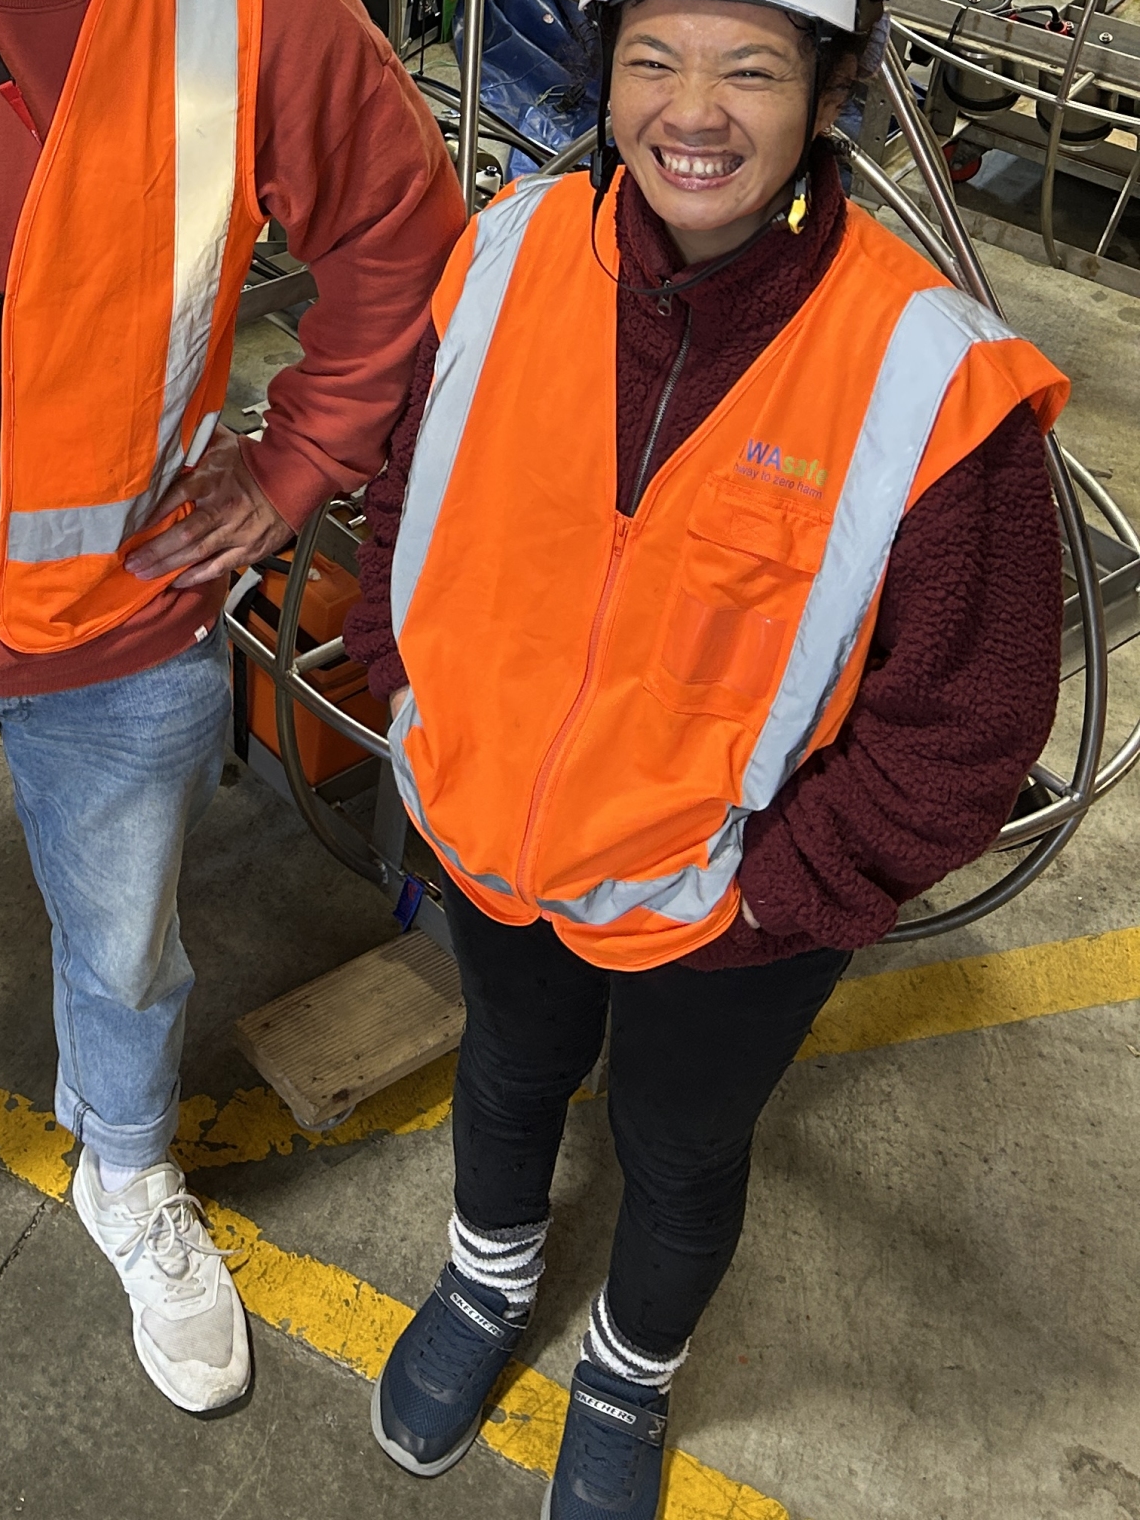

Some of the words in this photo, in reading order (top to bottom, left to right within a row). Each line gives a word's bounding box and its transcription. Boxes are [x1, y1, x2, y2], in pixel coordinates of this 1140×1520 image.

[761, 471, 771, 482] to
[773, 476, 796, 489] zero
[797, 482, 823, 500] harm
[452, 1293, 503, 1337] SKECHERS
[574, 1391, 635, 1423] SKECHERS
